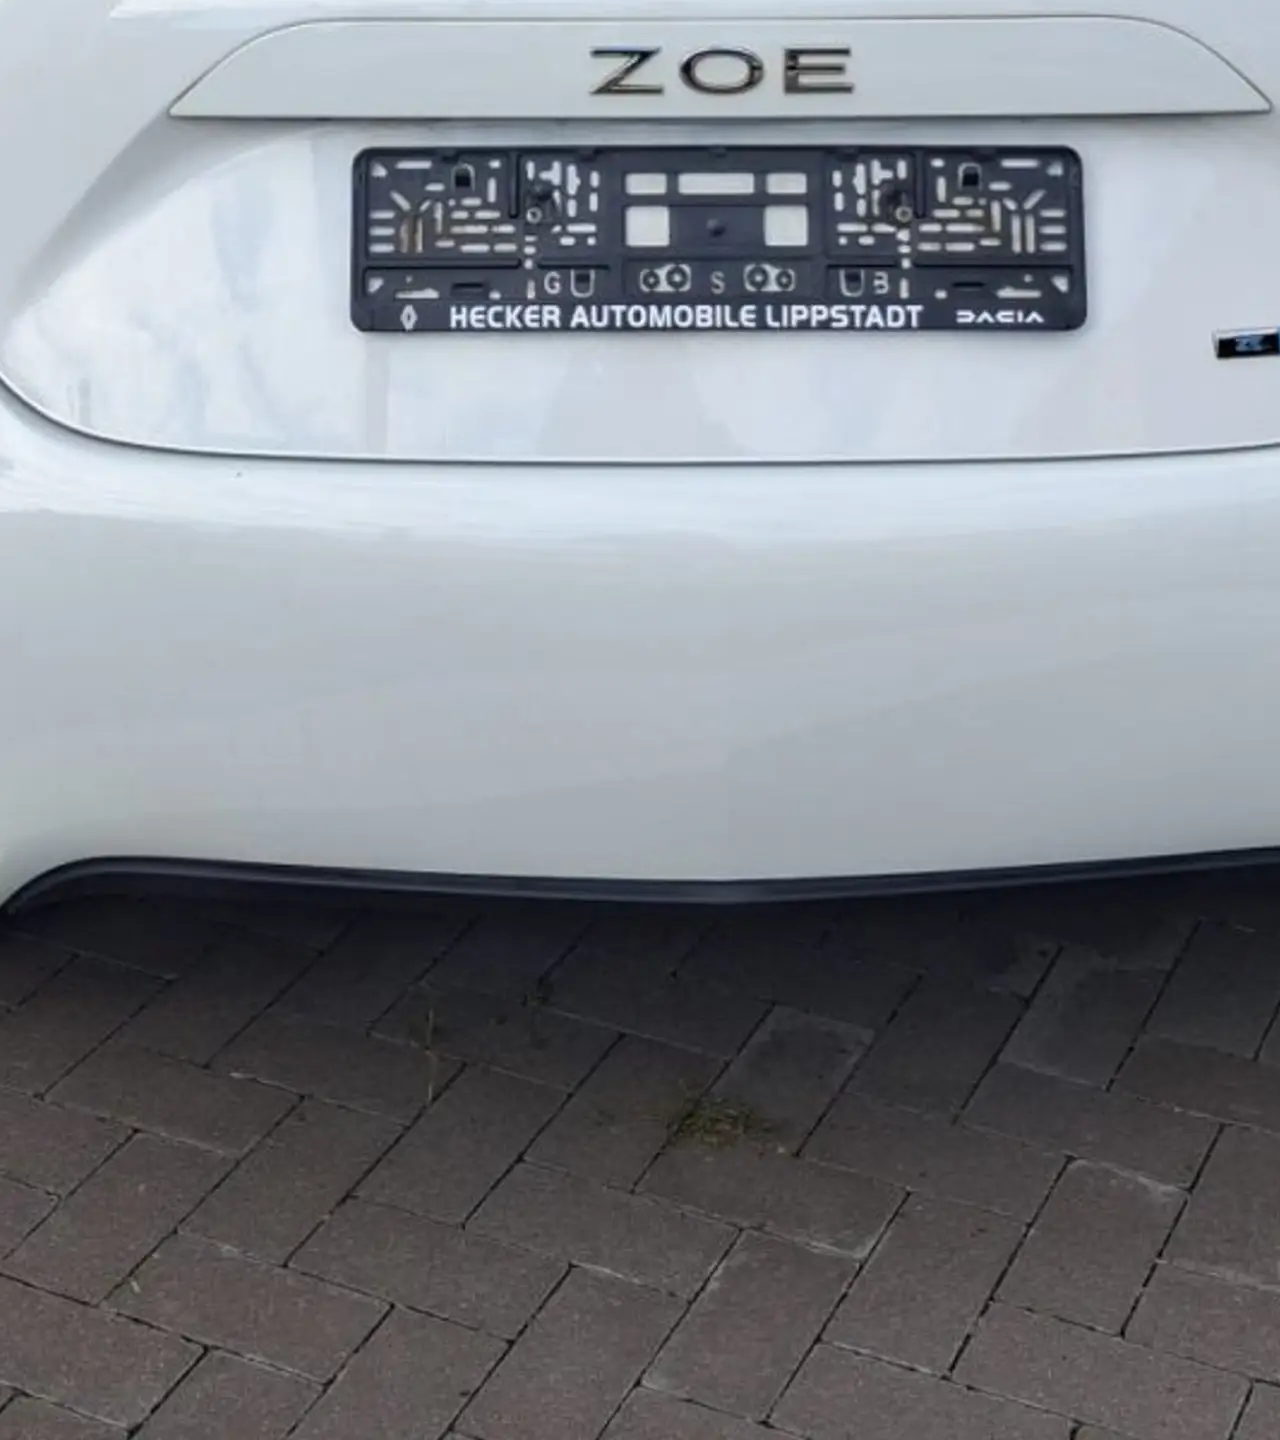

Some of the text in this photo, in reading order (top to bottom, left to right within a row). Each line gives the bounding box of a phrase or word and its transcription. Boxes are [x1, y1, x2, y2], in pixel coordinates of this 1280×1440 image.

[589, 45, 855, 95] ZOE
[543, 271, 563, 295] G
[710, 271, 725, 295] S
[450, 304, 1045, 329] HECKER AUTOMOBILE LIPPSTADT DACIA
